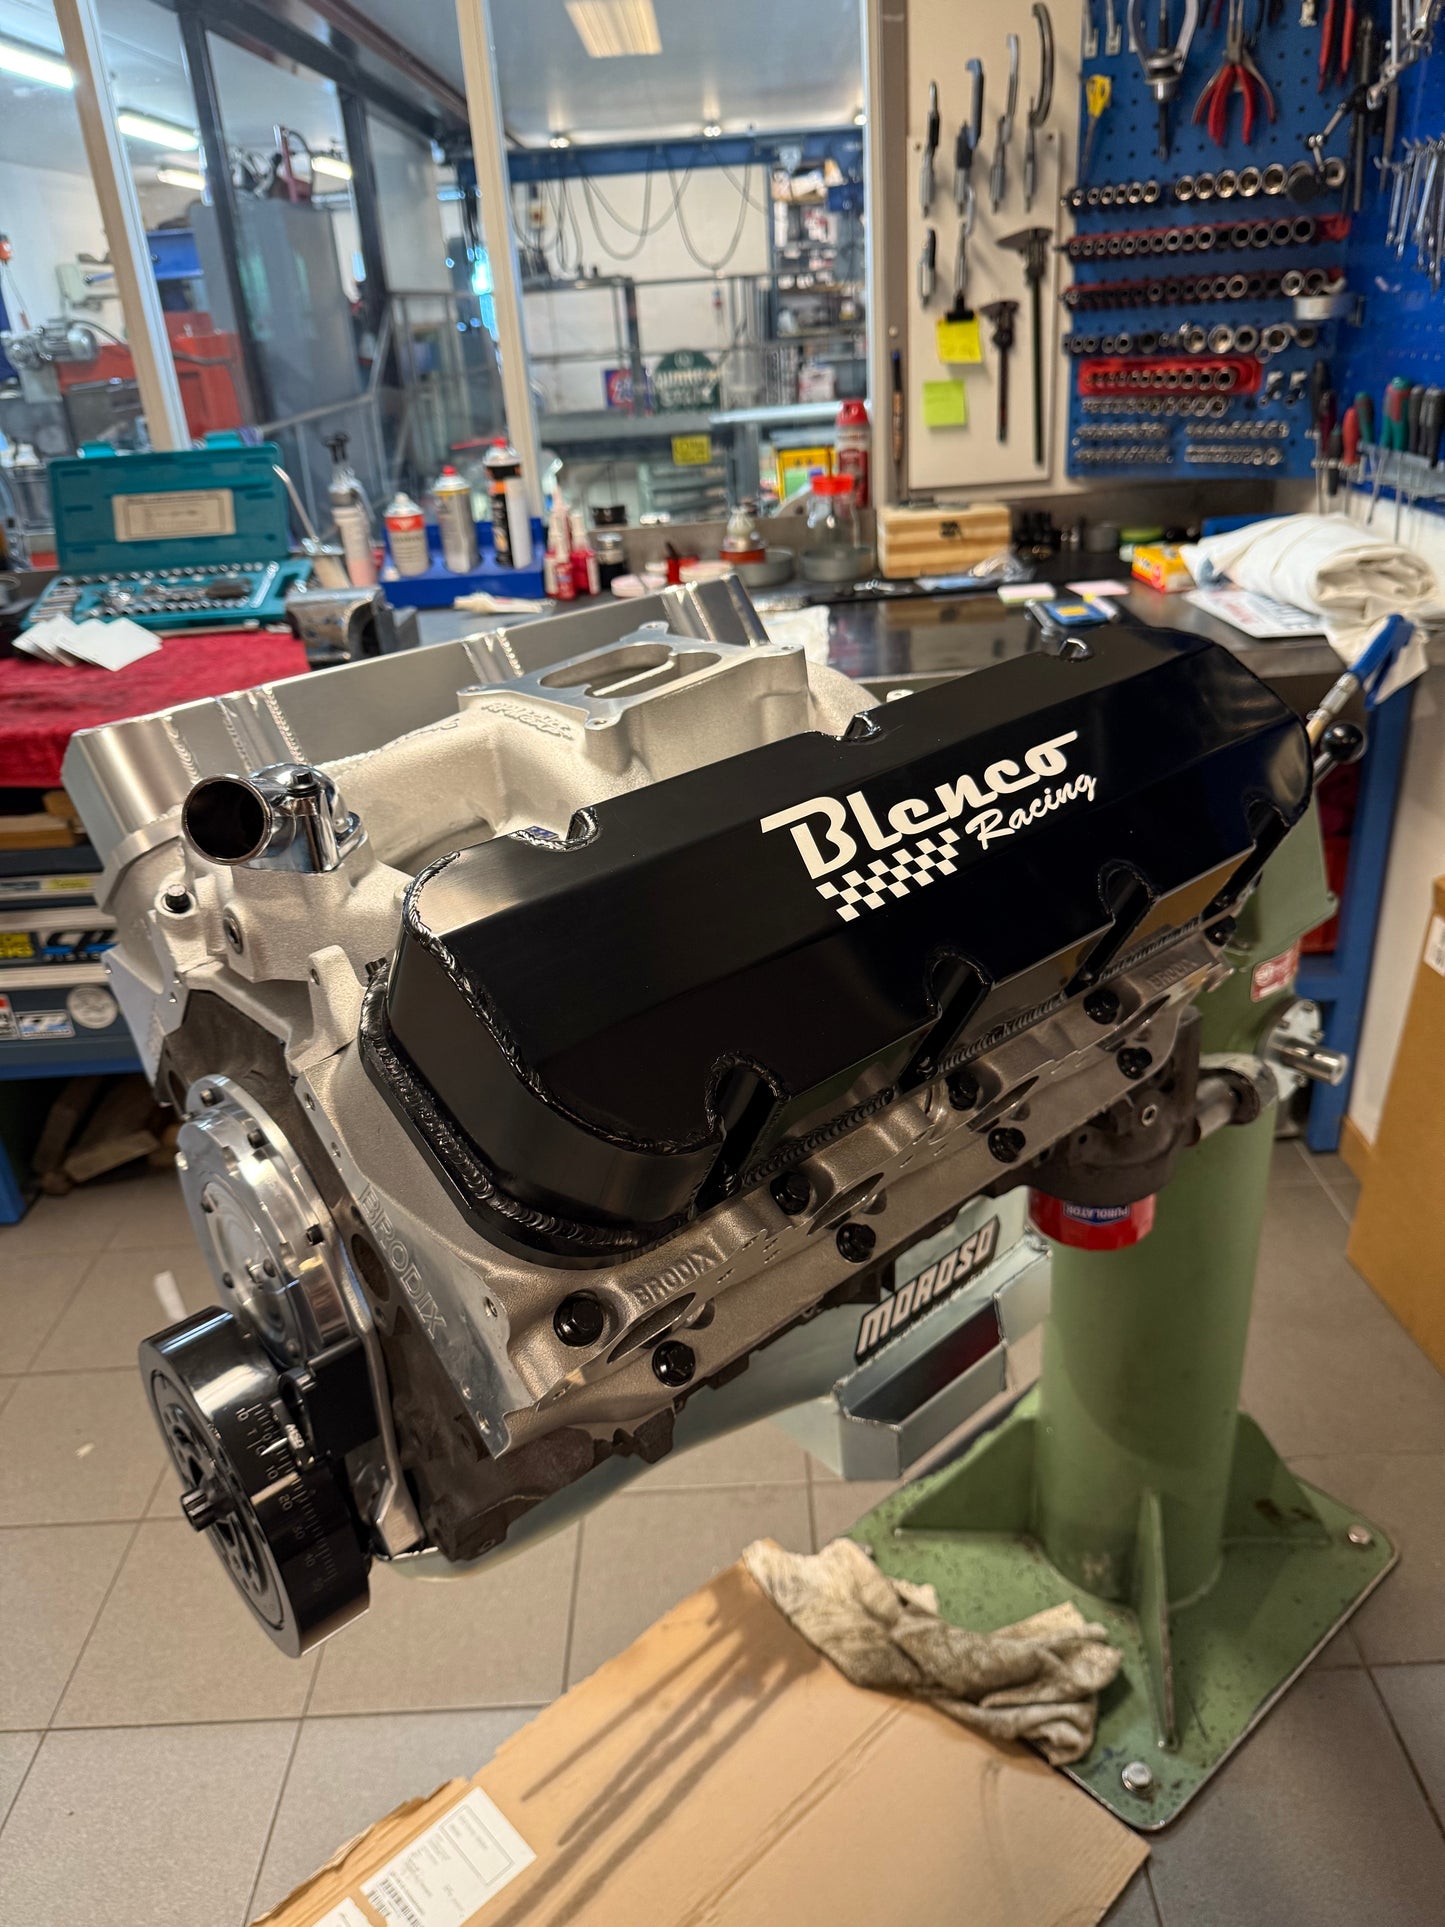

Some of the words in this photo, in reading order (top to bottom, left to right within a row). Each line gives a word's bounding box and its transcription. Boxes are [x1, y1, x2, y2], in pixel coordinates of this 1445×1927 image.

[965, 774, 1097, 849] Racing
[359, 1183, 447, 1340] BRODIX
[856, 1218, 997, 1355] MOROSO
[265, 1465, 279, 1480] 10
